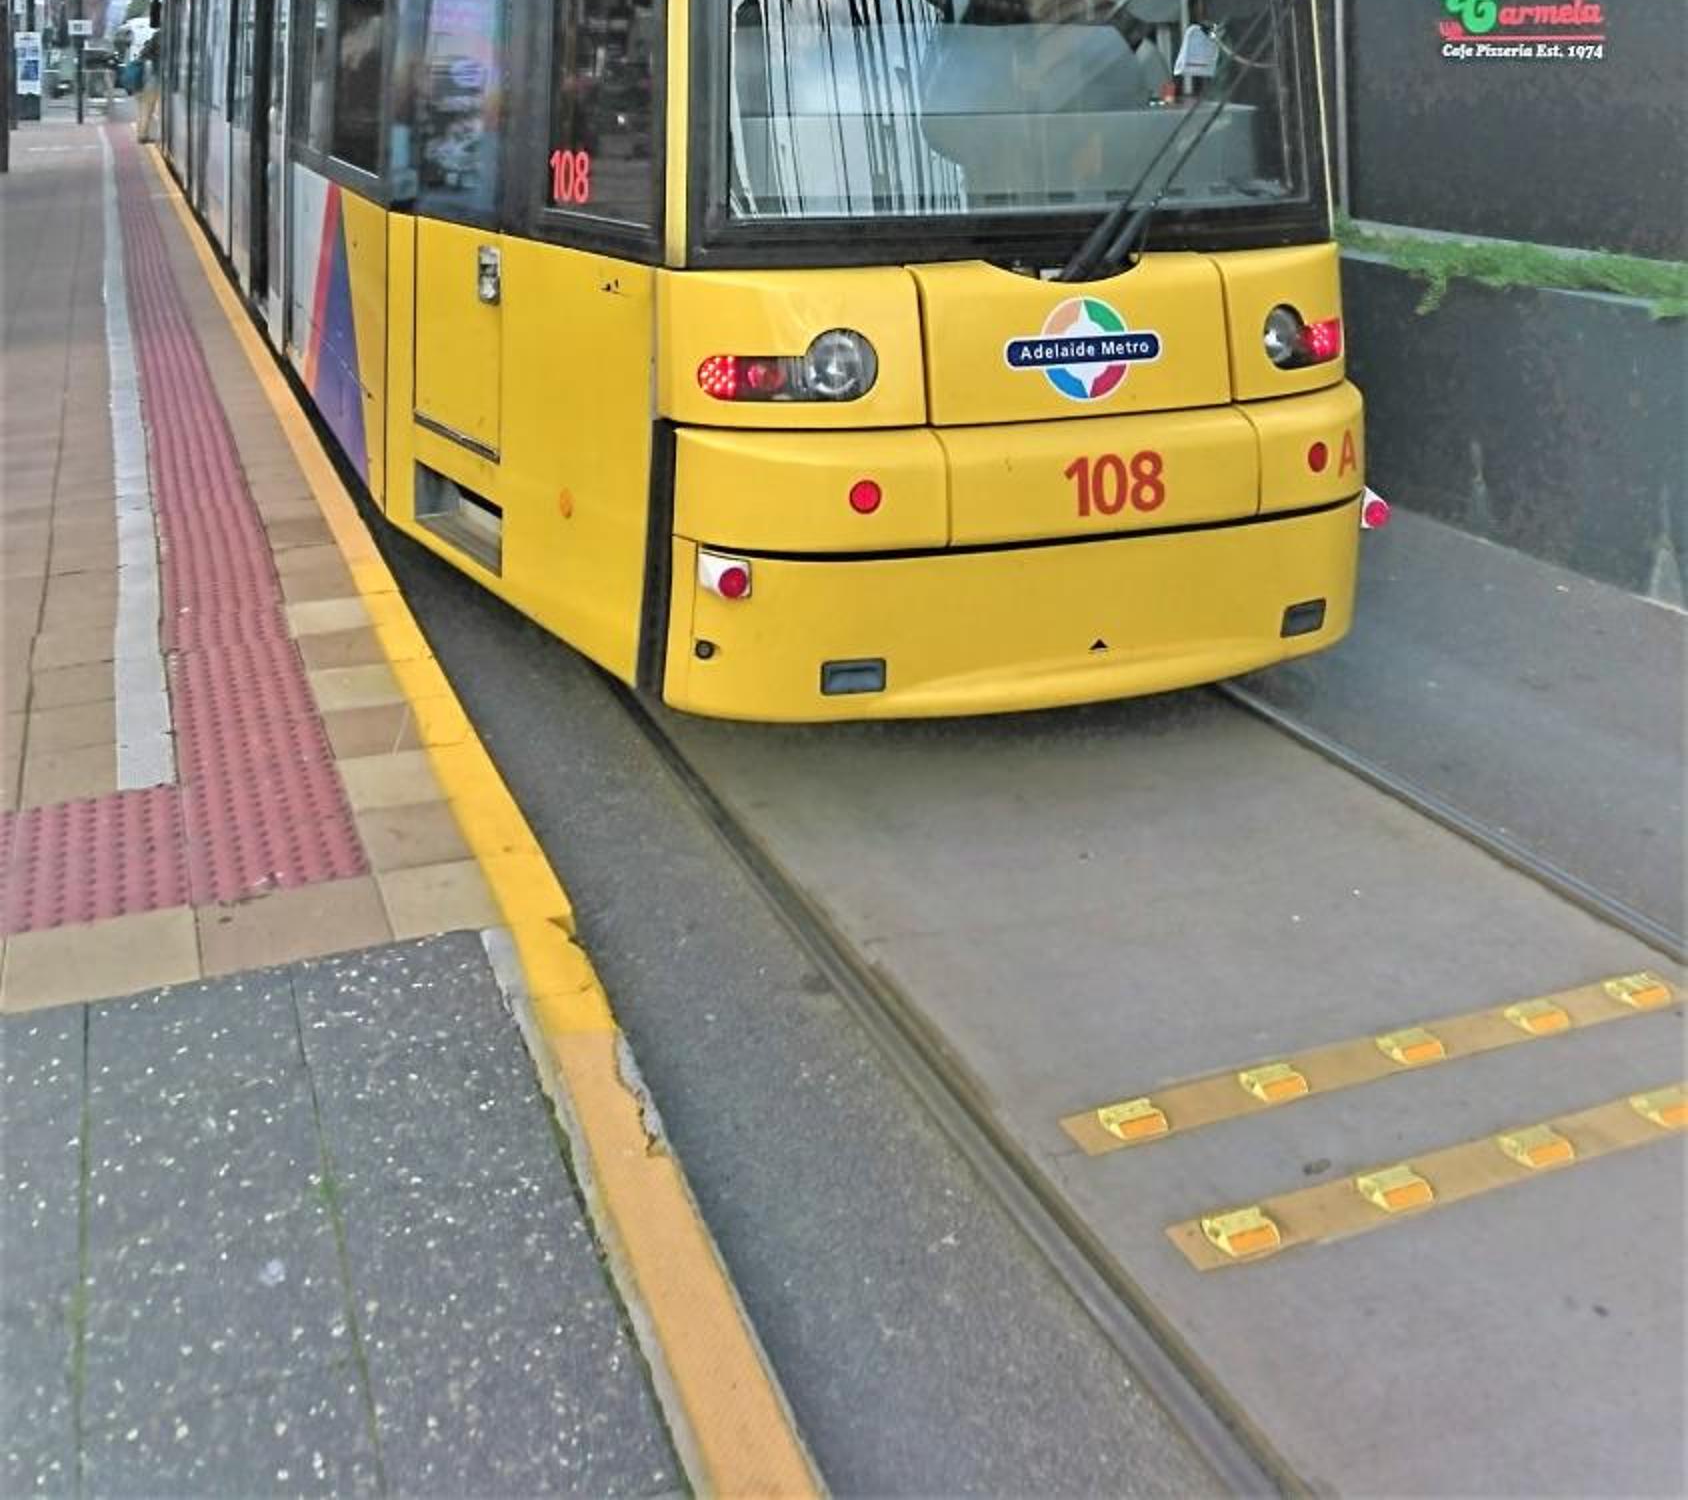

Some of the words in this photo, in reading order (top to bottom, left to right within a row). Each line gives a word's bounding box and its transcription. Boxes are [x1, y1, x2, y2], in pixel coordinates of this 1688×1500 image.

[1441, 43, 1473, 60] Cafe
[1475, 43, 1533, 58] Pizzeria
[1535, 43, 1564, 58] Est.
[1566, 44, 1604, 60] 1974
[549, 149, 589, 204] 108
[1020, 341, 1096, 361] Adelaide
[1101, 340, 1150, 356] Metro
[1338, 428, 1358, 479] A
[1063, 449, 1166, 518] 108
